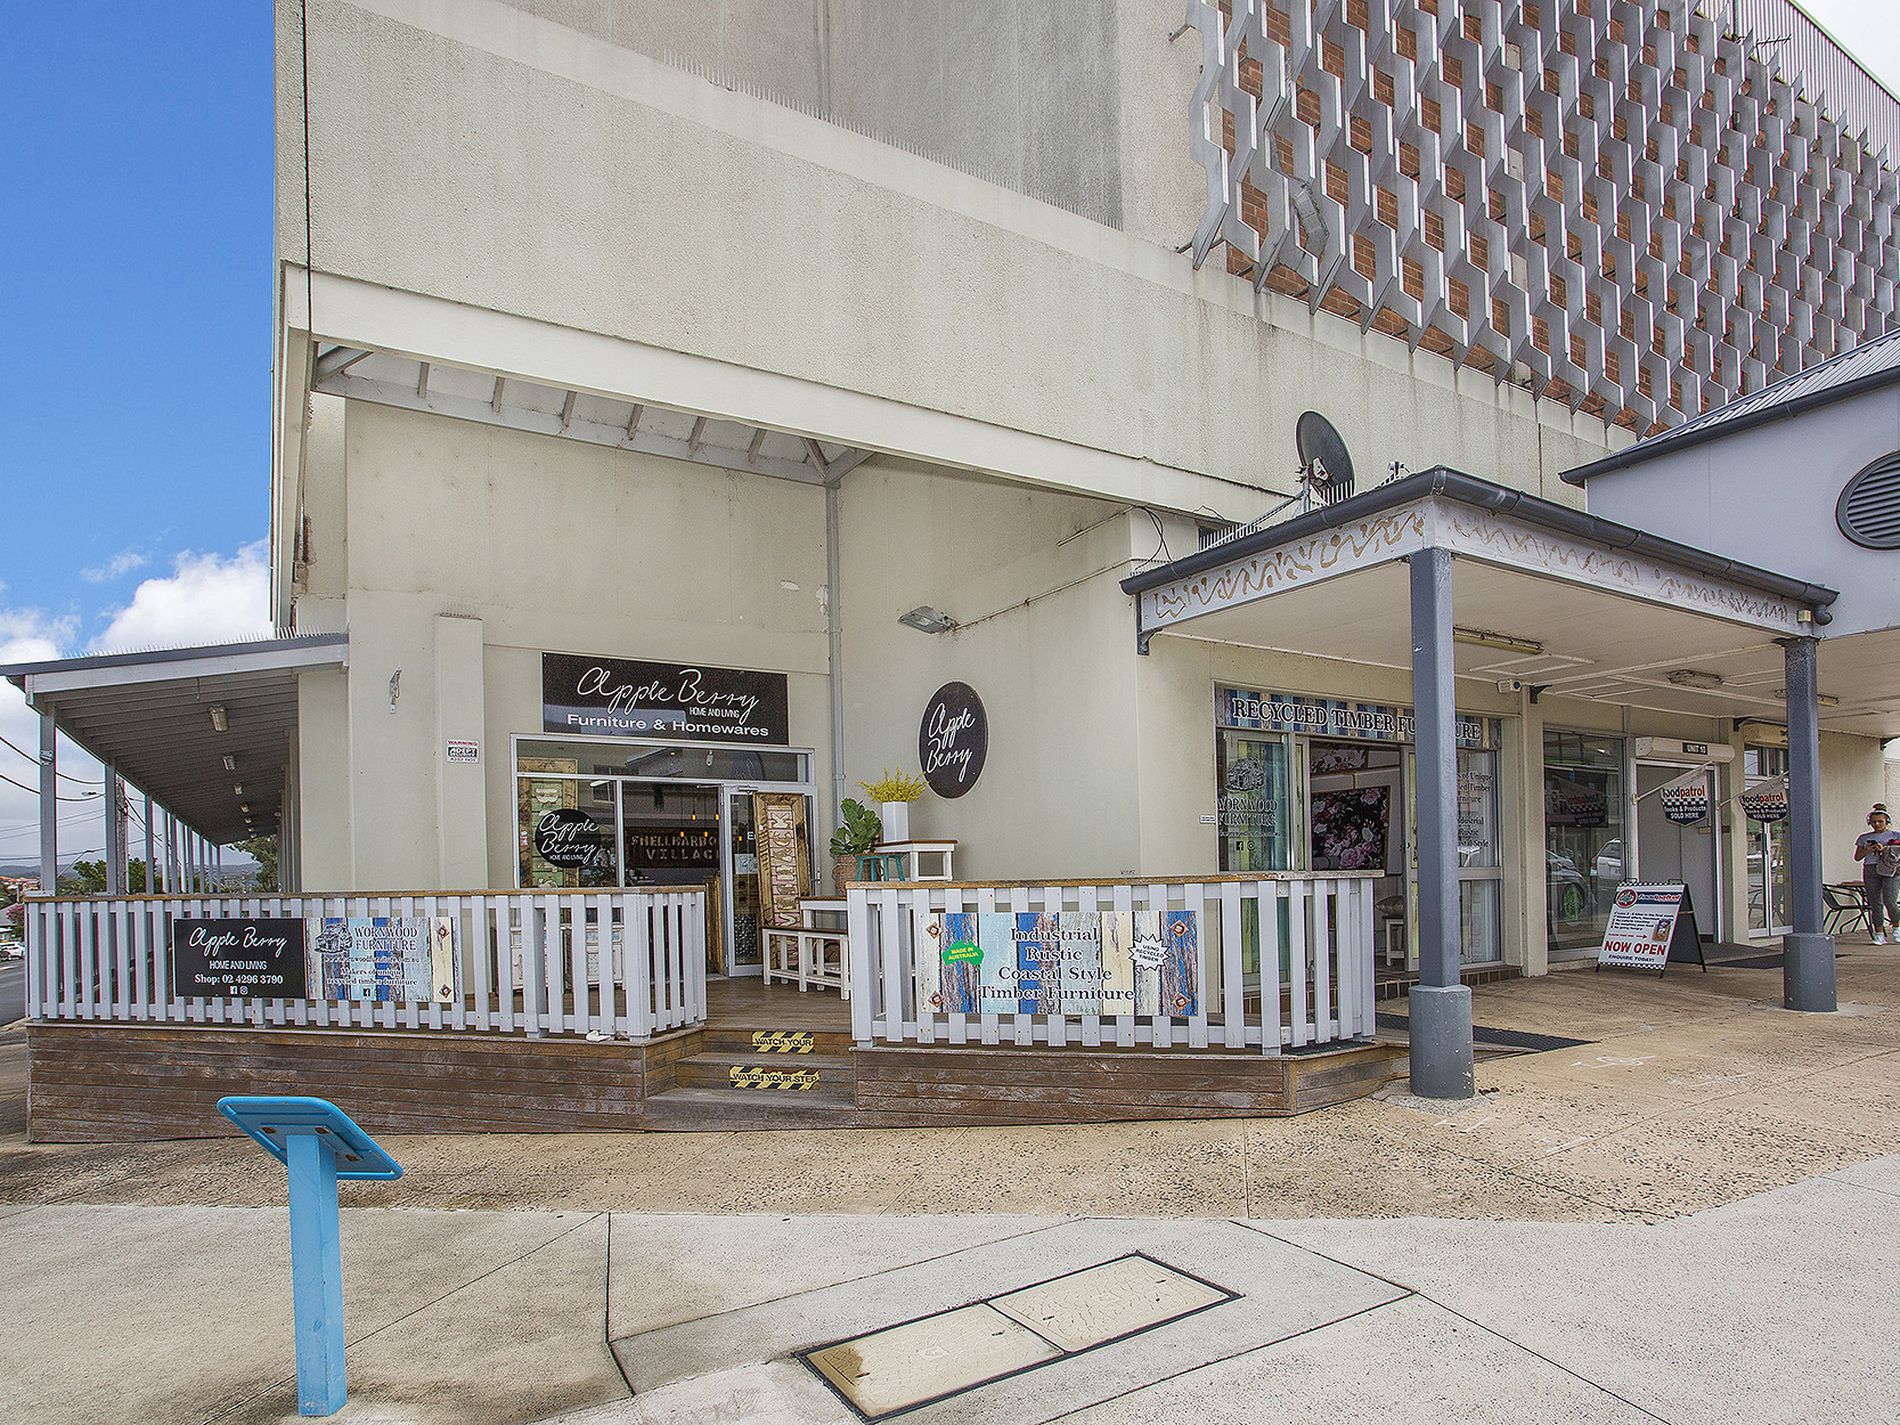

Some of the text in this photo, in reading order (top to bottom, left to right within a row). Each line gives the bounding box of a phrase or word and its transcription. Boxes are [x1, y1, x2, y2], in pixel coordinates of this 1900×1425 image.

[577, 667, 760, 725] Apple Berry
[689, 707, 740, 719] HOME AND LIVING
[1233, 698, 1481, 741] RECYCLED TIMBER FUURE
[568, 713, 769, 737] Furniture & Homewares
[929, 703, 975, 749] Apple
[927, 738, 972, 783] Berry
[1663, 785, 1705, 800] foodpatrol
[539, 813, 600, 842] Apple
[541, 831, 597, 864] Berry
[646, 849, 719, 860] VILLAG
[355, 926, 418, 938] WORNWOOD
[1011, 927, 1098, 941] Industrial
[189, 927, 287, 958] Apple Berry
[356, 940, 417, 951] FURNITURE
[1604, 941, 1667, 955] NOW OPEN
[948, 952, 978, 960] AUSTRALIA
[1025, 947, 1083, 961] Rustic
[210, 961, 267, 970] HOME AND LIVING
[195, 974, 284, 985] Shop: 02 4296 3790
[998, 967, 1113, 983] Coastal Style
[979, 986, 1135, 1000] Timber Furniture
[755, 1038, 811, 1047] WATCH YOUR
[733, 1073, 817, 1083] WATCH YOUR STEP
